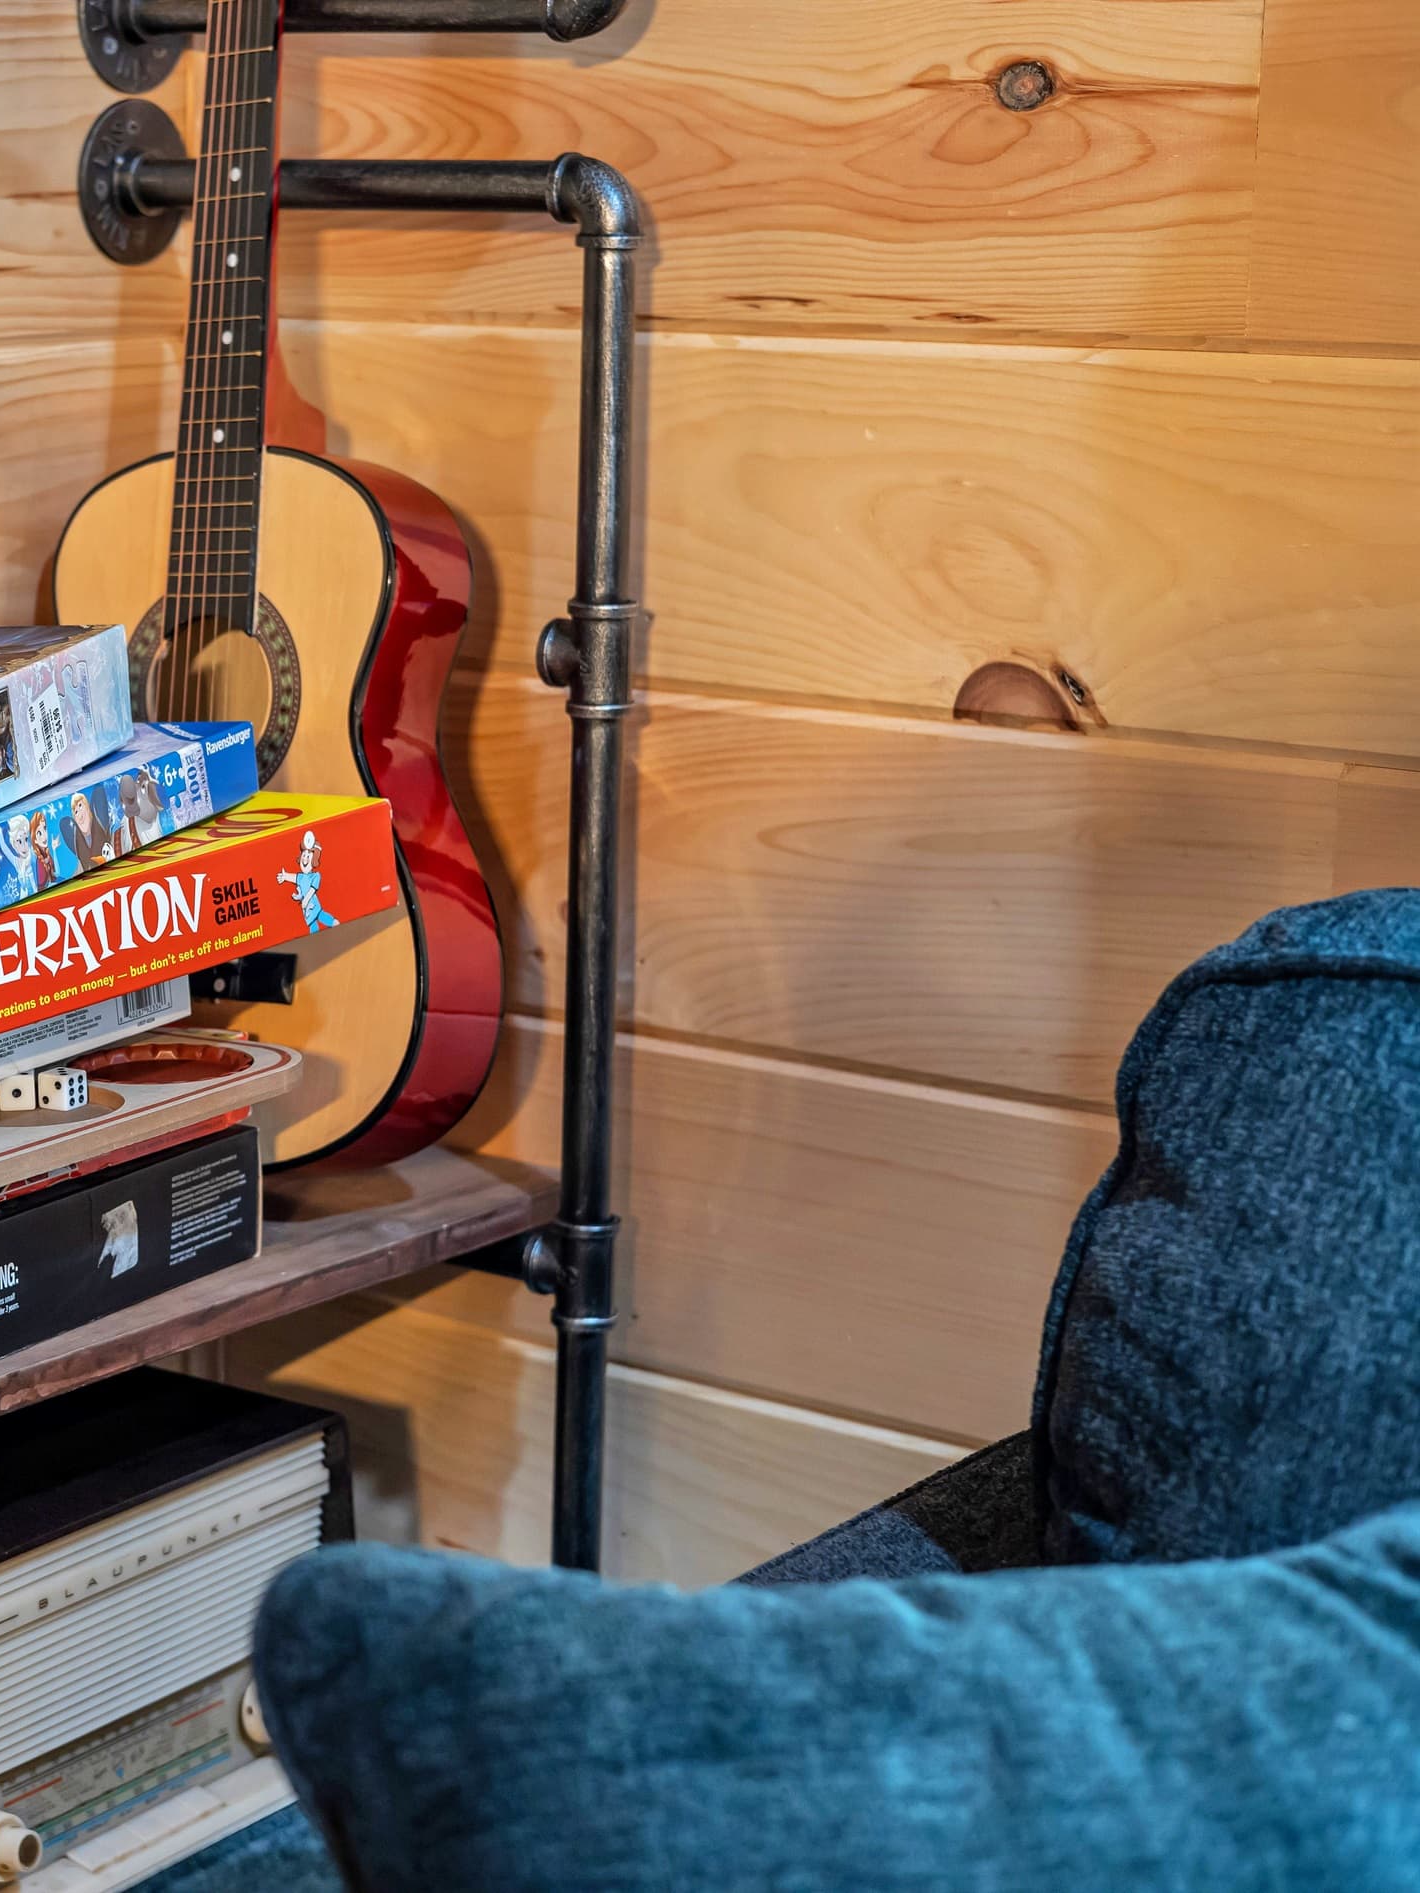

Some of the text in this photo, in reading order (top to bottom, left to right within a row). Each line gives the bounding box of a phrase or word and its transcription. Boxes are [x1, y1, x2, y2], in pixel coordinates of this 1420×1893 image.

[205, 728, 251, 756] Ravensburger
[211, 877, 258, 905] SKILL
[214, 897, 261, 925] GAME
[39, 995, 51, 1006] to
[53, 985, 78, 1001] earn
[81, 974, 114, 993] money
[130, 963, 147, 977] but
[150, 953, 176, 971] don't
[178, 948, 195, 963] set
[197, 941, 212, 956] off
[214, 936, 230, 951] the
[232, 924, 264, 945] alarm!
[38, 1513, 242, 1610] BLAUPUNKT
